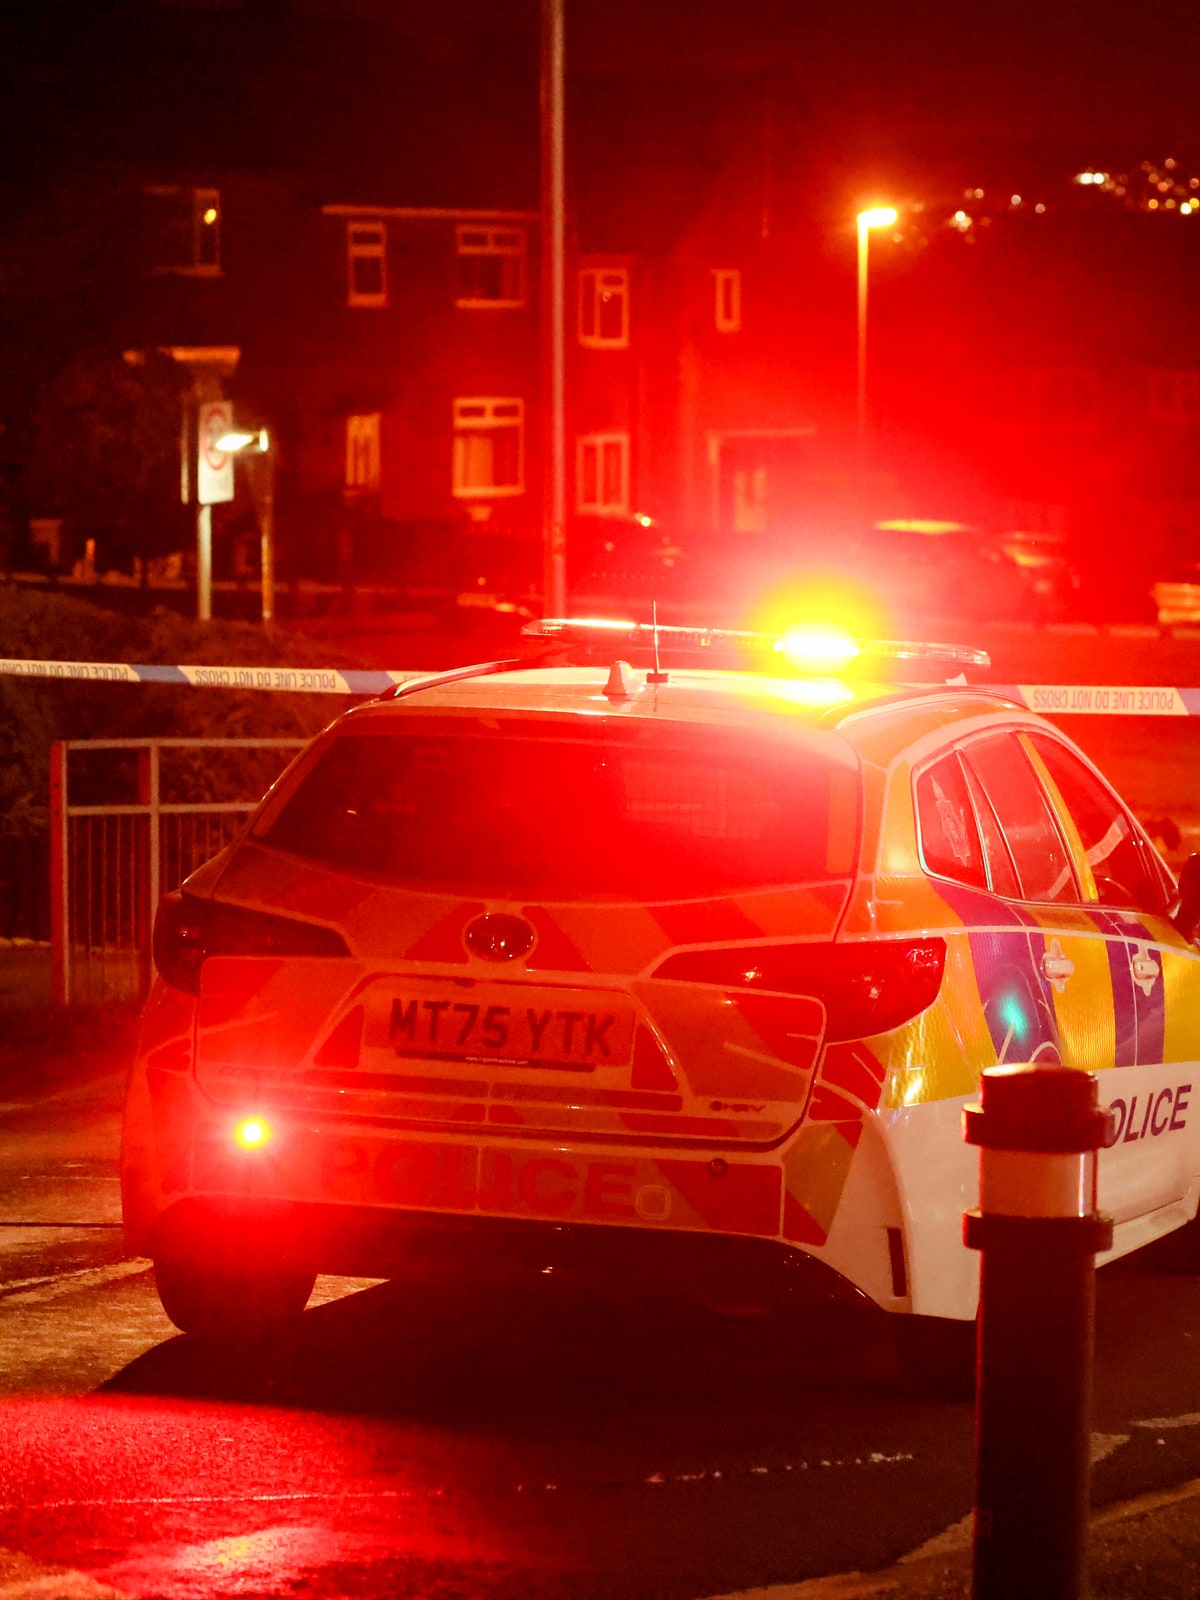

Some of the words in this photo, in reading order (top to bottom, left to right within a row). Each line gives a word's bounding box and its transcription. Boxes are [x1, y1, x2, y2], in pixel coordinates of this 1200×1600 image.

[195, 670, 230, 685] CROSS
[233, 671, 254, 686] NOT
[257, 672, 271, 687] DO
[274, 672, 297, 687] LINE
[300, 673, 336, 688] POLICE
[1034, 689, 1068, 708] CROSS
[1070, 690, 1092, 709] NOT
[1095, 691, 1110, 709] DO
[1112, 691, 1135, 710] LINE
[1138, 691, 1174, 710] POLICE
[389, 998, 511, 1049] MT75
[526, 1008, 616, 1057] YTK
[1108, 1084, 1192, 1147] OLICE
[320, 1143, 638, 1215] POLICE
